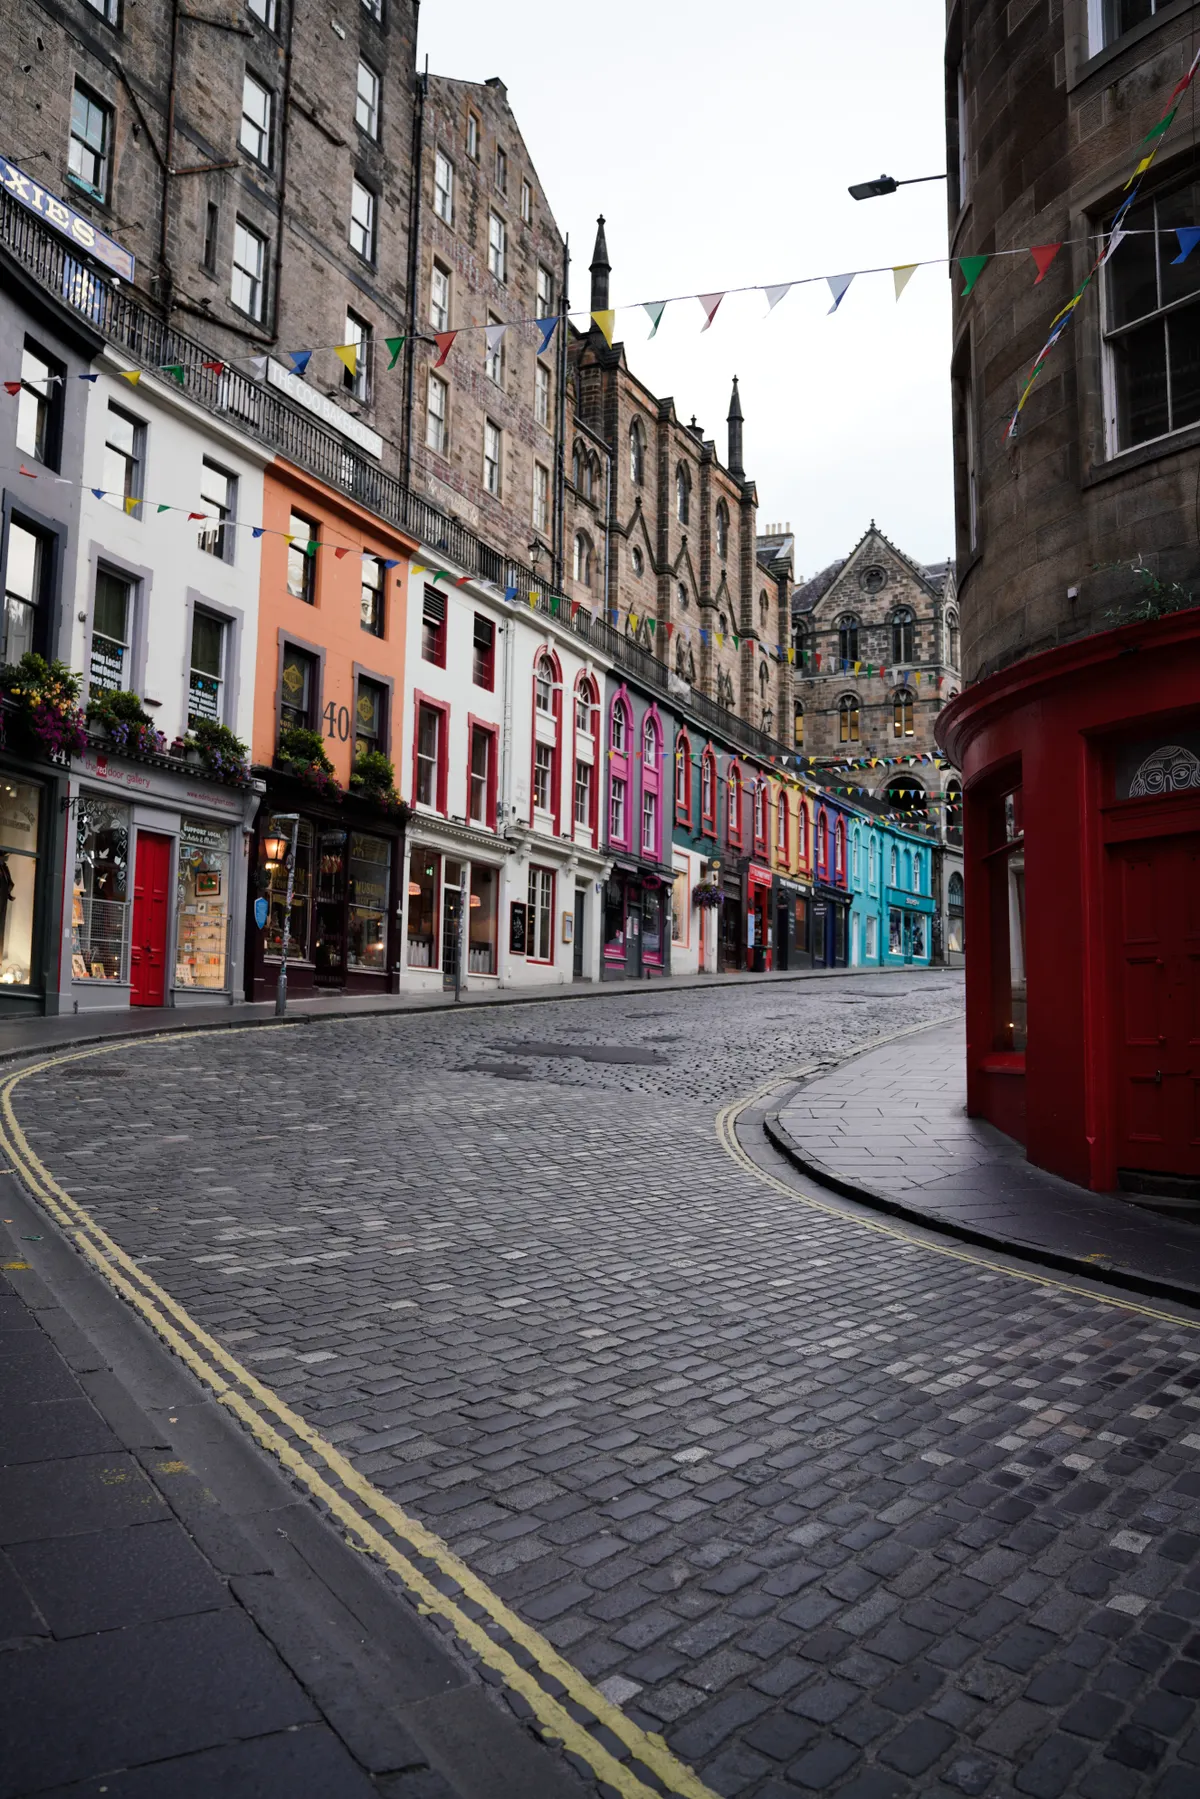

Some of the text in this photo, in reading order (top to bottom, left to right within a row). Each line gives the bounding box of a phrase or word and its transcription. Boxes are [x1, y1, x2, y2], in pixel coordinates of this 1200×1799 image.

[0, 164, 95, 247] XIES
[271, 363, 381, 451] THE COO BAKEHOUSE
[323, 700, 350, 742] 40
[85, 760, 151, 789] the red door gallery
[184, 825, 221, 839] SUPPORT LOCAL
